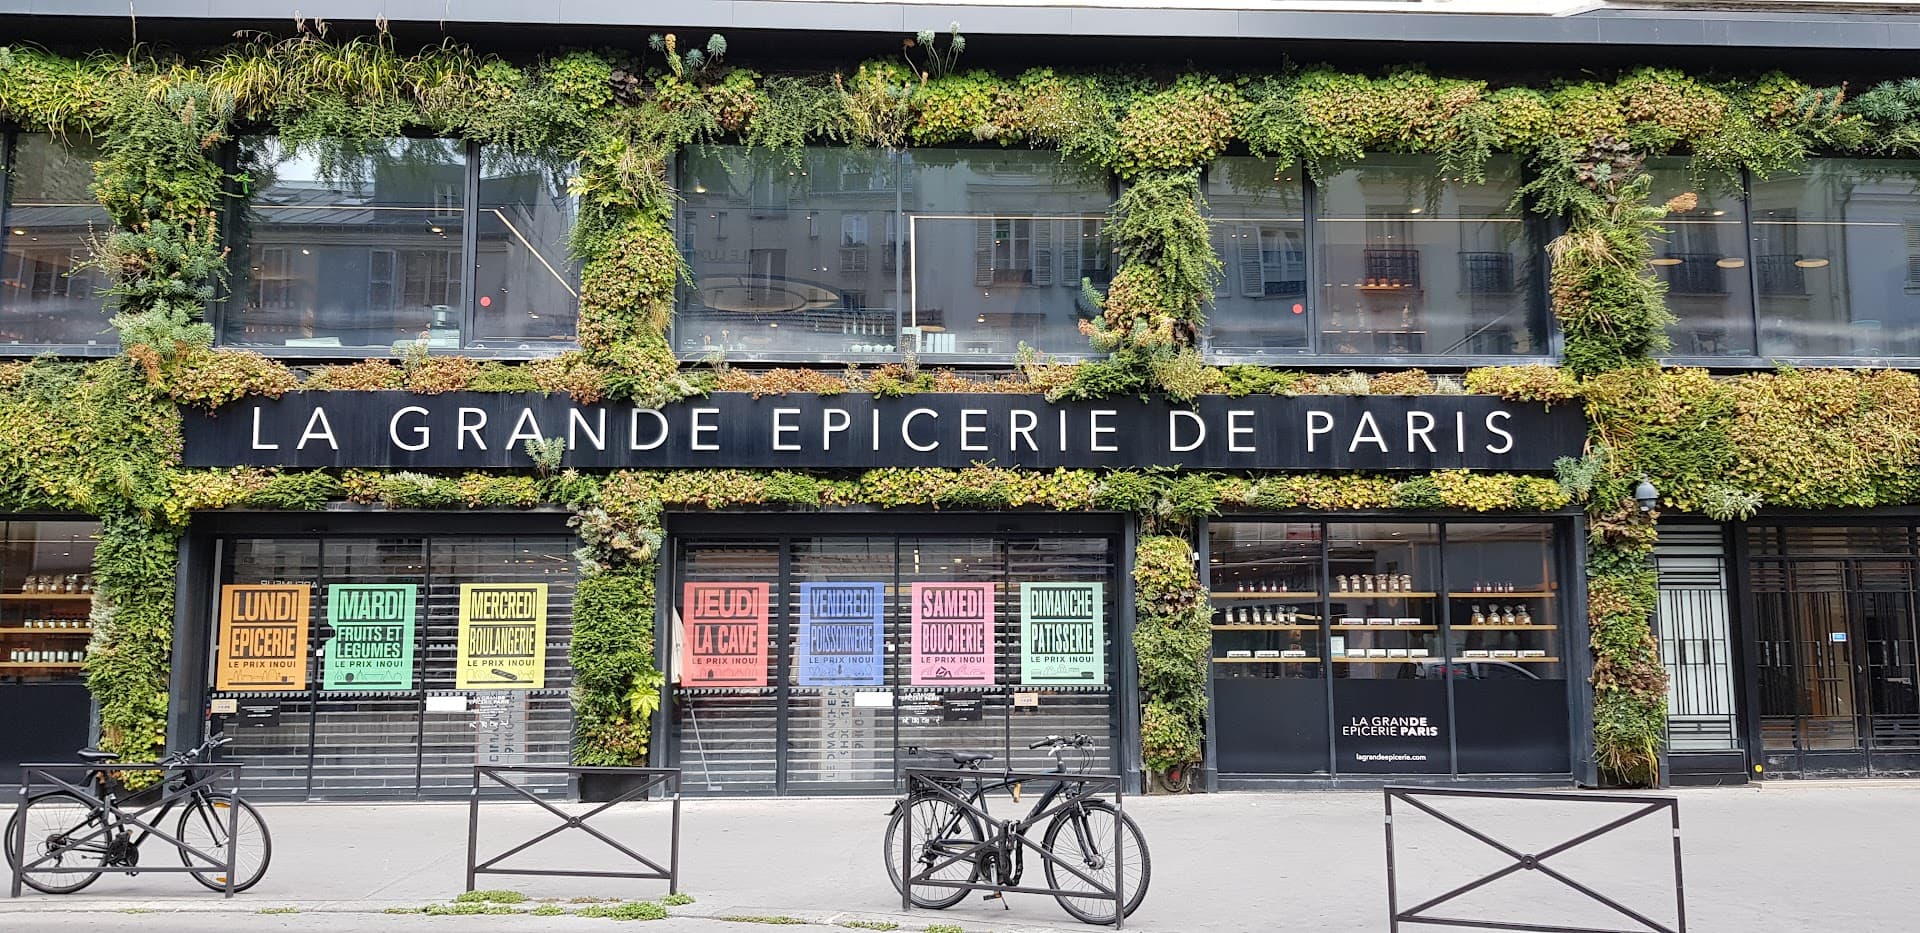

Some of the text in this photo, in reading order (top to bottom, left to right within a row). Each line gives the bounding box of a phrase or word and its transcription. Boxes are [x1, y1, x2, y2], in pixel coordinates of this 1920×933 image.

[251, 405, 1514, 454] LA GRANDE EPICERIE DE PARIS
[233, 592, 298, 621] LUNDI
[338, 591, 404, 620] MARDI
[470, 591, 536, 619] MERCREDI
[695, 590, 758, 617] JEUDI
[812, 590, 872, 616] VENDREDI
[922, 590, 983, 617] SAMEDI
[1032, 590, 1092, 616] DIMANCHE
[231, 628, 296, 656] EPICERIE
[338, 626, 402, 641] FRUITS ET
[469, 628, 534, 654] BOULANGERIE
[694, 624, 757, 654] LA CAVE
[811, 626, 872, 652] POISSONNERIE
[923, 624, 983, 652] BOUCHERIE
[1032, 624, 1093, 652] PATISSERIE
[336, 642, 400, 658] LEGUMES
[1342, 726, 1438, 736] EPICERIE PARIS
[1352, 716, 1428, 726] LA GRANDE
[1356, 752, 1426, 762] lagrandeepicerie.com
